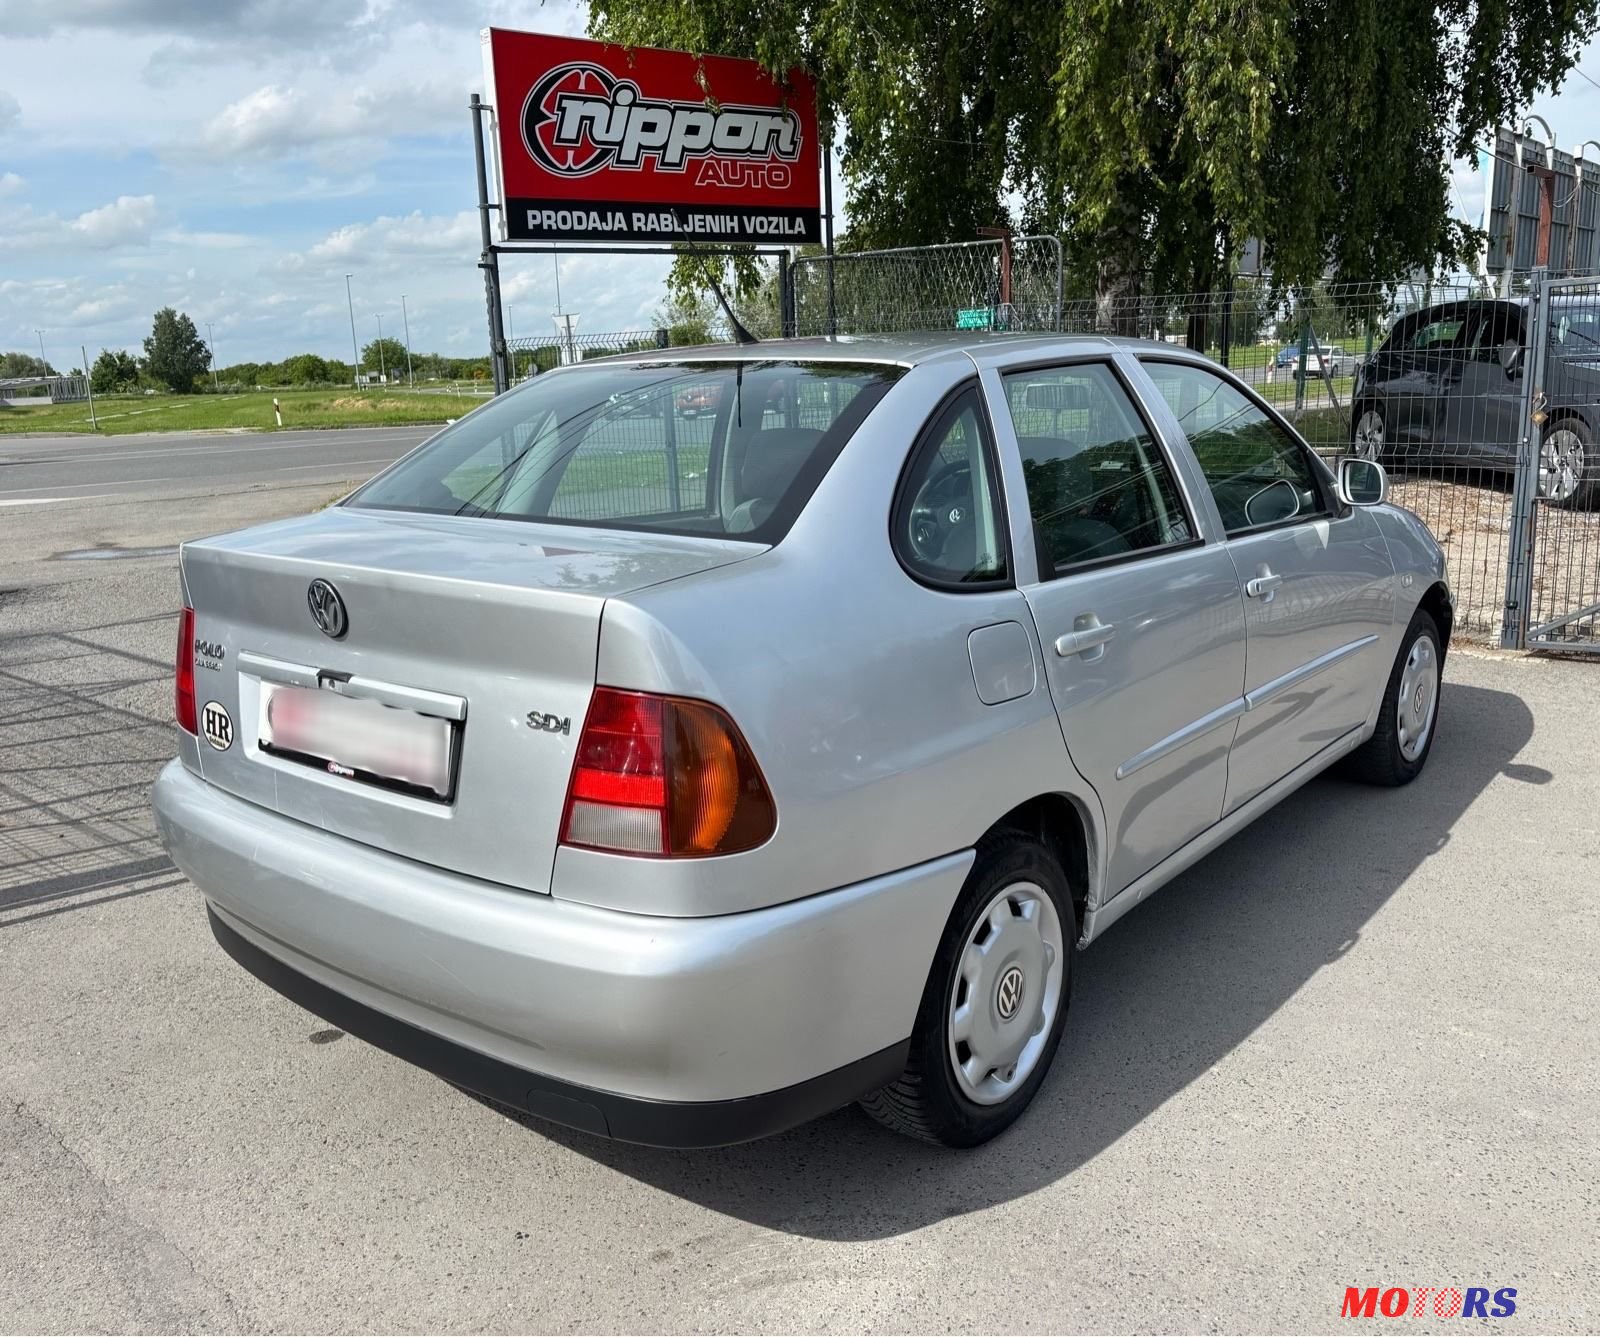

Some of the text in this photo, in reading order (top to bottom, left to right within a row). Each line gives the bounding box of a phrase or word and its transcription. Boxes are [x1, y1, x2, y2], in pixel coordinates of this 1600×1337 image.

[556, 85, 800, 169] nippon
[695, 160, 791, 189] AUTO
[526, 209, 806, 235] PRODAJA RABLJENIH VOZILA
[205, 707, 230, 743] HR
[526, 710, 571, 736] SDI
